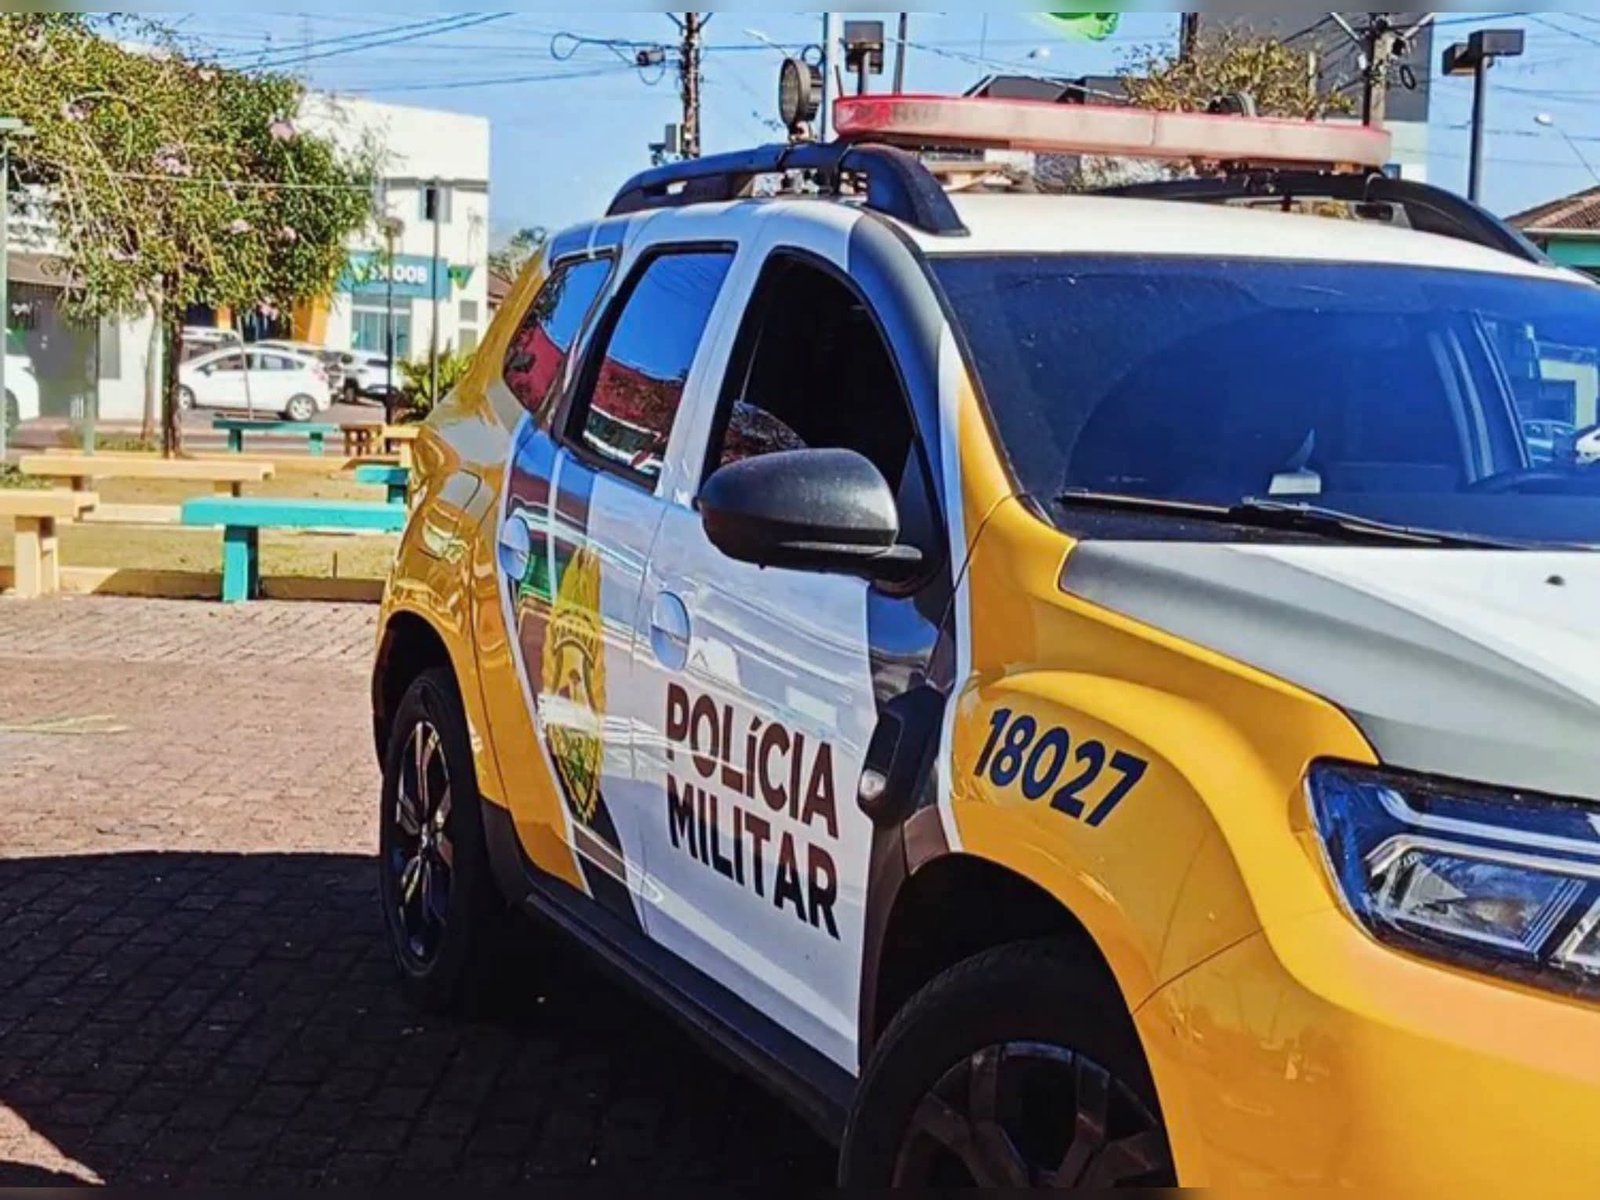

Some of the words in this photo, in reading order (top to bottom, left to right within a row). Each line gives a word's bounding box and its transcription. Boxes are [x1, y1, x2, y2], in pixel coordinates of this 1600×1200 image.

[667, 682, 838, 839] POLÍCIA
[973, 708, 1149, 827] 18027
[667, 773, 840, 940] MILITAR
